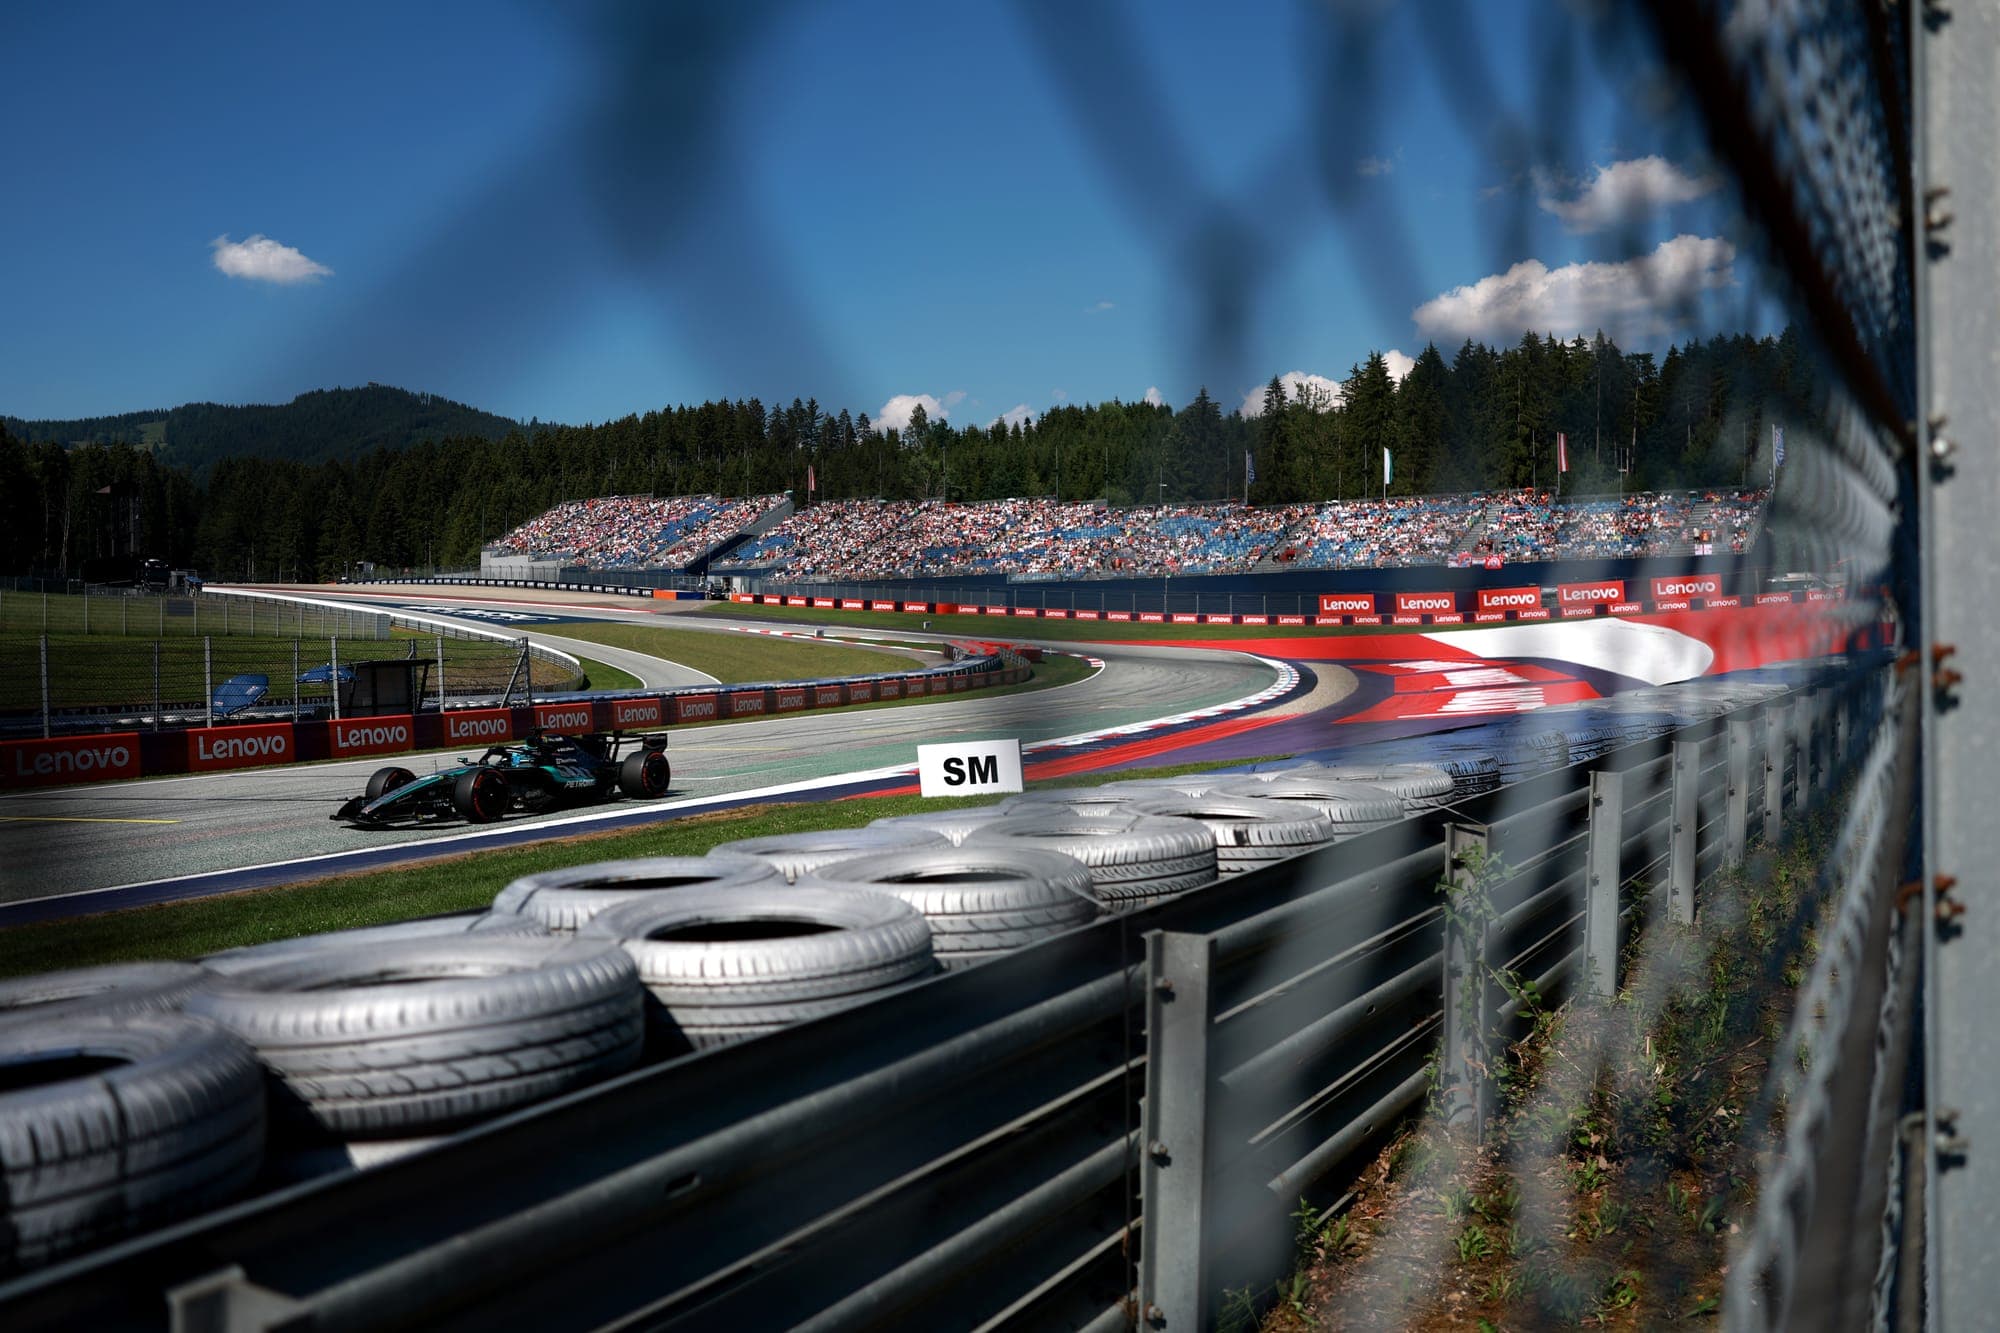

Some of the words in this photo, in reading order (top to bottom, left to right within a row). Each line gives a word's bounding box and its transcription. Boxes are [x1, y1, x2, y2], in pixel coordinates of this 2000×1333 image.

[1562, 588, 1619, 601] Lenovo
[1656, 582, 1716, 595] Lenovo
[1323, 599, 1370, 610] Lenovo
[1400, 597, 1450, 610] Lenovo
[1483, 594, 1535, 607] Lenovo
[1657, 602, 1687, 610] Lenovo
[1706, 599, 1737, 607] Lenovo
[1756, 595, 1789, 604] Lenovo
[1519, 610, 1547, 618] Lenovo
[1563, 607, 1592, 617] Lenovo
[1609, 604, 1639, 613] Lenovo
[1279, 616, 1303, 624] Lenovo
[1316, 616, 1340, 624] Lenovo
[1354, 615, 1379, 624] Lenovo
[1393, 616, 1419, 624] Lenovo
[1434, 615, 1460, 623] Lenovo
[1475, 613, 1503, 621] Lenovo
[778, 694, 803, 708] Lenovo
[817, 691, 839, 704] Lenovo
[680, 702, 714, 718] Lenovo
[734, 698, 762, 713] Lenovo
[540, 711, 588, 729] Lenovo
[617, 705, 658, 723] Lenovo
[450, 718, 507, 738] Lenovo
[336, 725, 407, 748] Lenovo
[198, 735, 286, 760] Lenovo
[16, 746, 130, 776] Lenovo
[943, 755, 999, 786] SM
